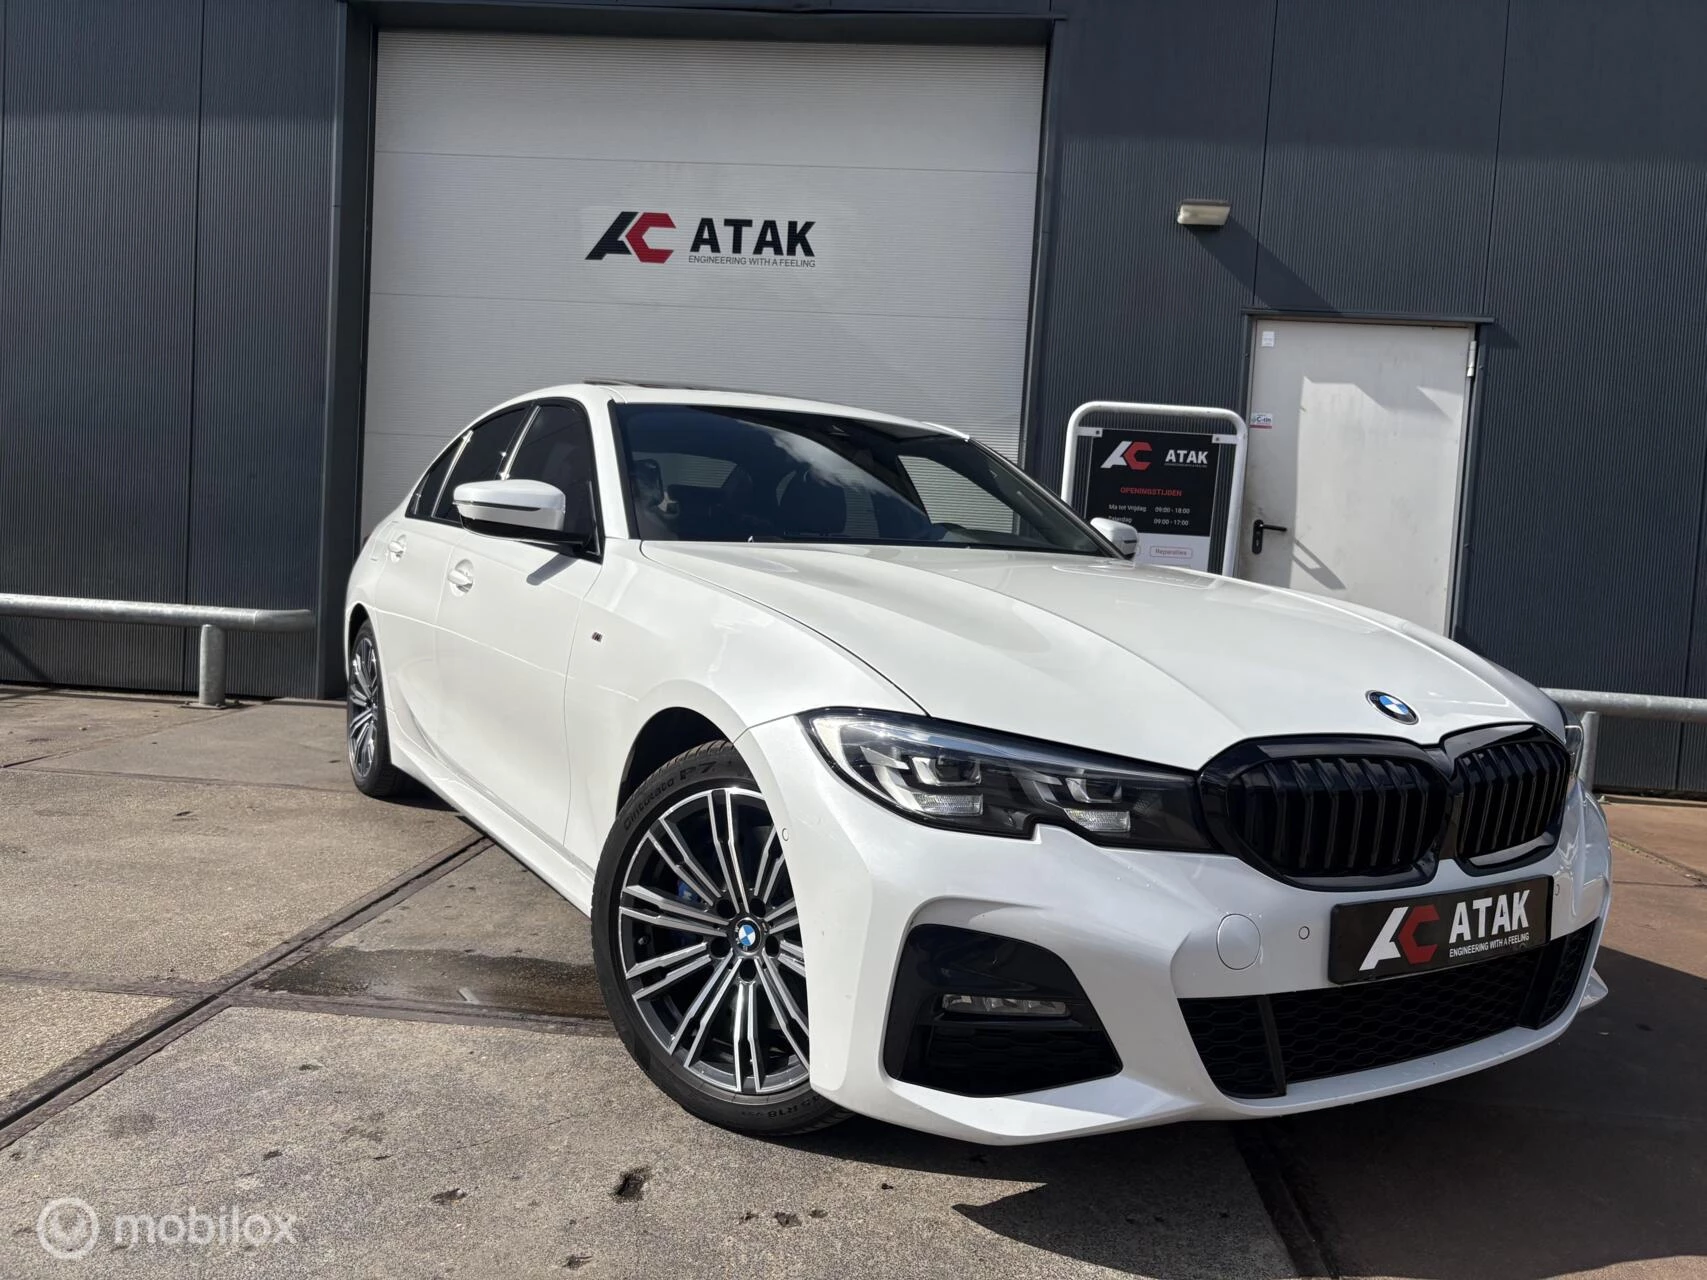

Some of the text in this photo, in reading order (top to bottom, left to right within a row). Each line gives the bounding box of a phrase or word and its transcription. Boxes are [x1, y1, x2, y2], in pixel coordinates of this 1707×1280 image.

[690, 217, 816, 257] ATAK
[688, 255, 815, 268] ENGINEERING WITH A FEELING
[1165, 449, 1208, 465] ATAK
[1120, 487, 1182, 497] OPENINGSTIJDEN
[1449, 889, 1530, 944] ATAK
[1449, 932, 1530, 958] ENGINEERING WITH A FEELING
